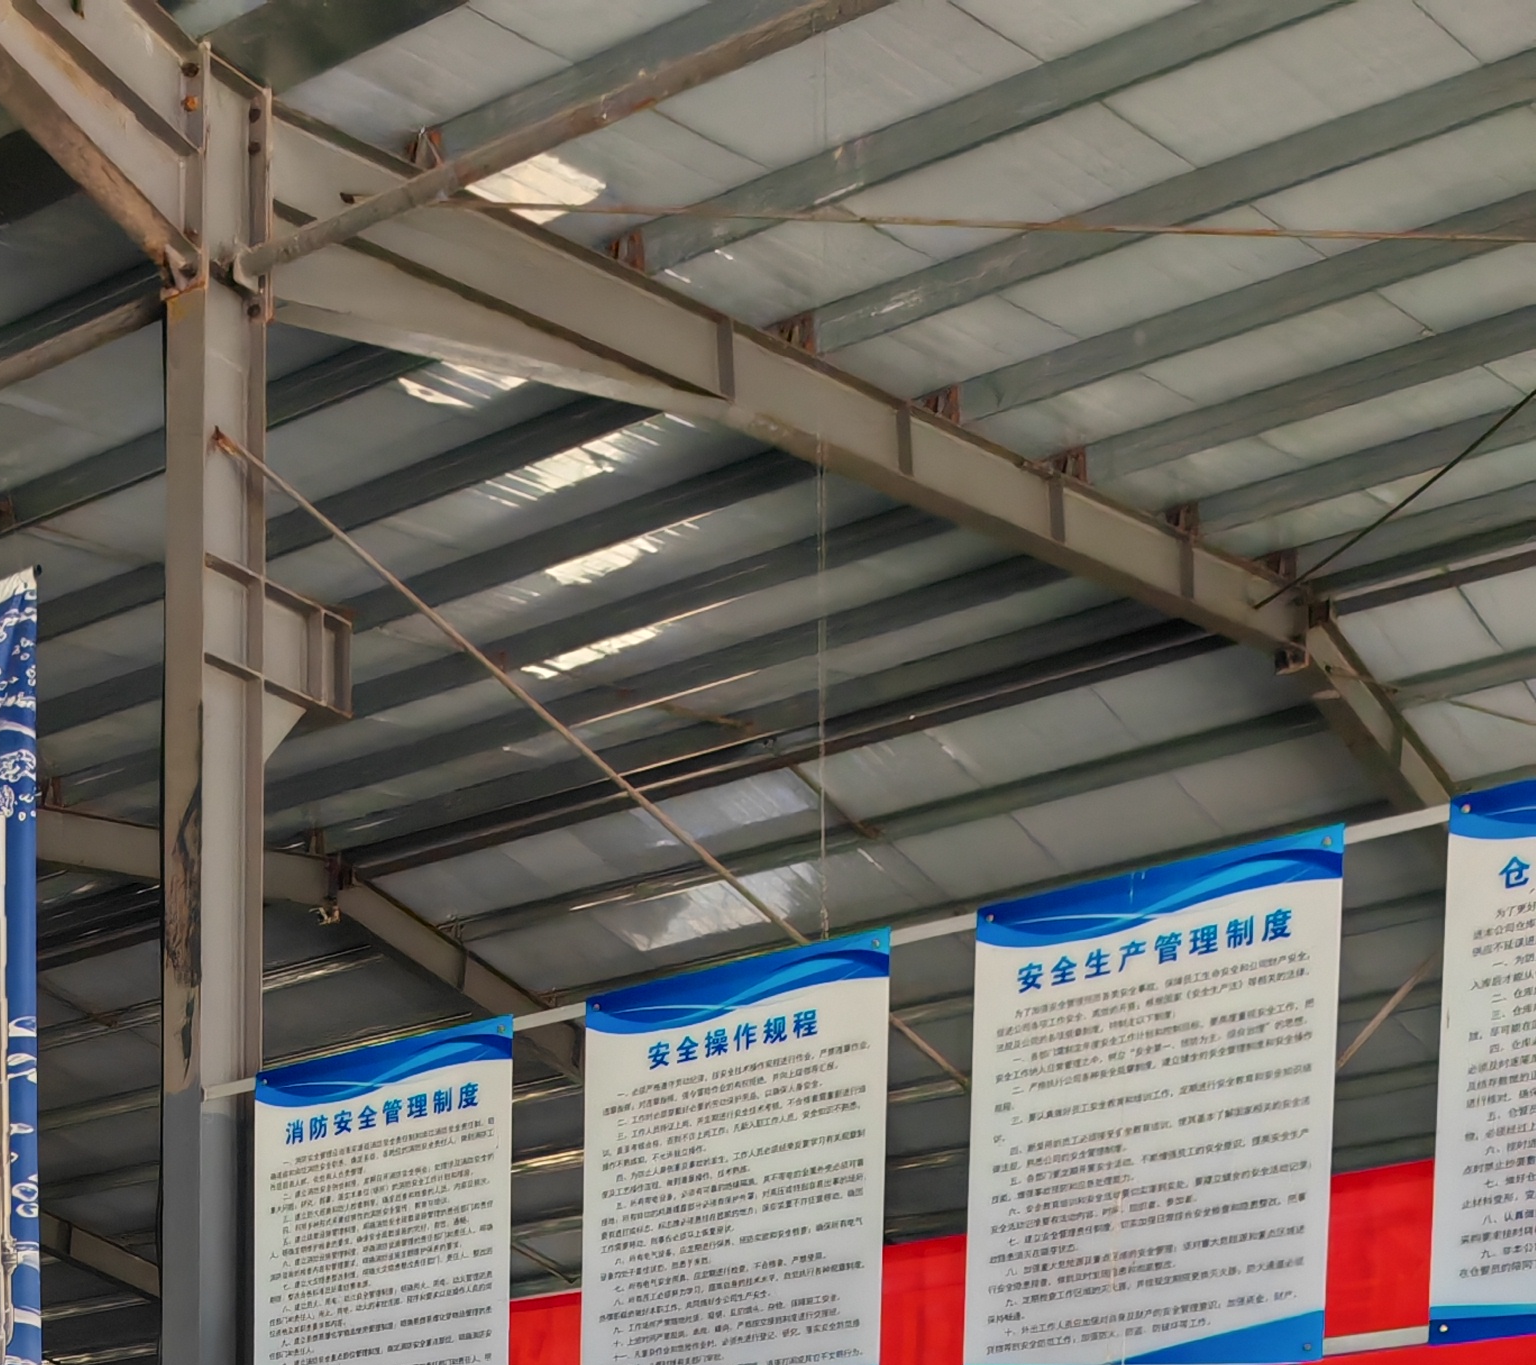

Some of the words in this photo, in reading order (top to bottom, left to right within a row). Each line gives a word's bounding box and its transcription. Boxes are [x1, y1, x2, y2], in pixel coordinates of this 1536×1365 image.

[1499, 856, 1531, 888] 仓
[1017, 908, 1293, 994] 安全生产管理制度
[647, 1008, 818, 1070] 安全操作规程
[284, 1082, 479, 1146] 消防安全管理制度
